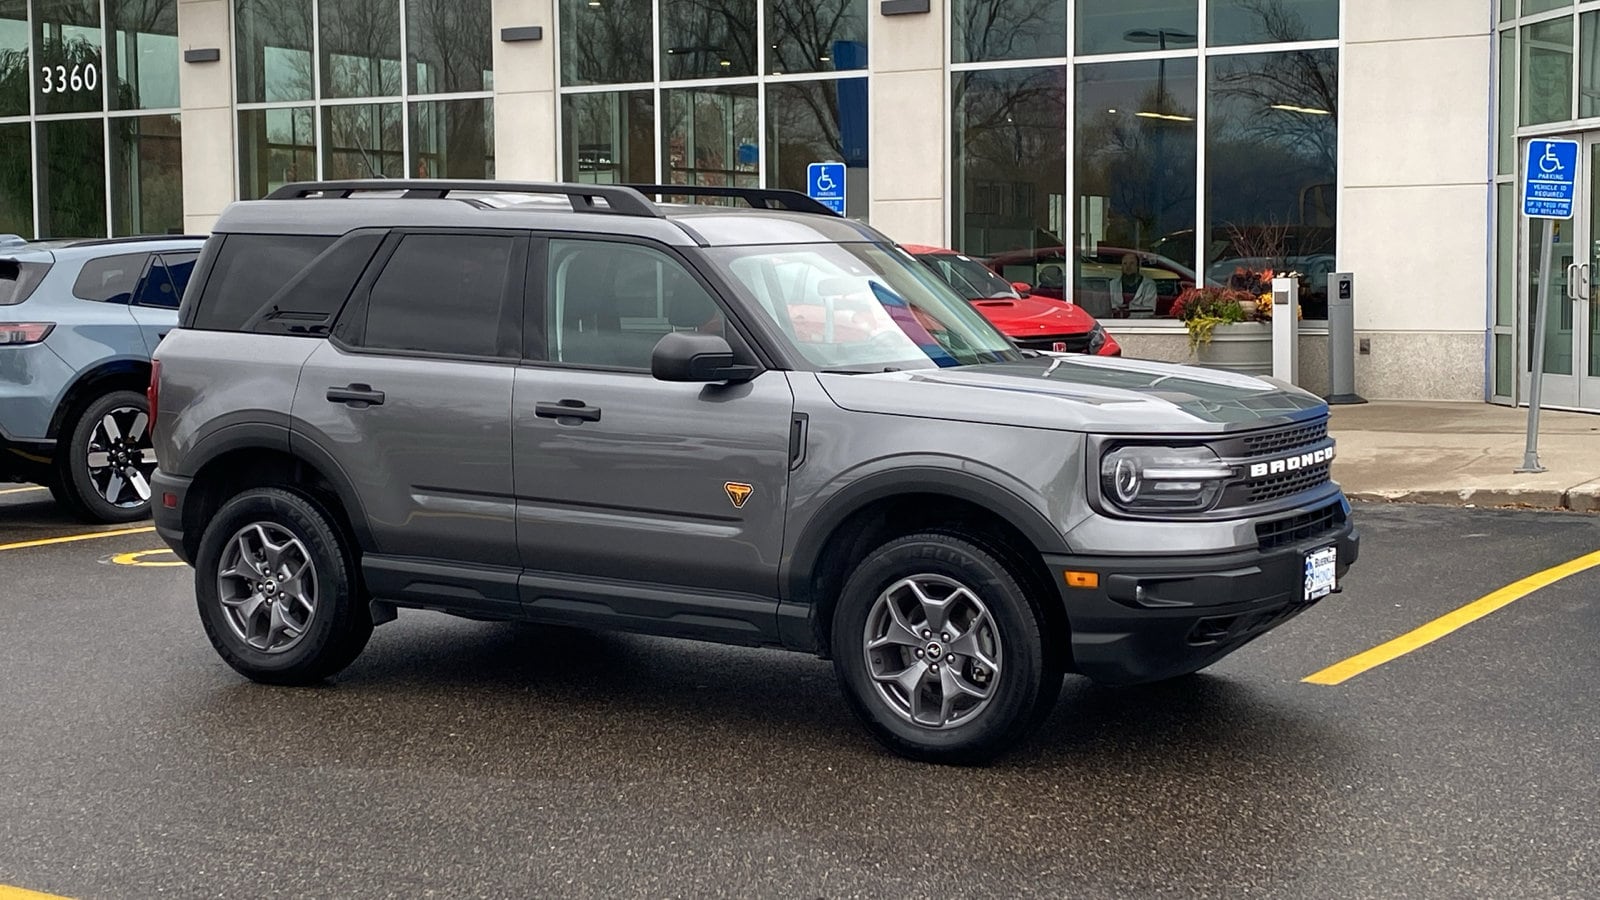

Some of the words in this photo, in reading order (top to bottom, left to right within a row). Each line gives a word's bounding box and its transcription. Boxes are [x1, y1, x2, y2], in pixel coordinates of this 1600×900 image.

[42, 63, 97, 94] 3360
[1250, 446, 1334, 478] BRONCO
[907, 546, 974, 567] KELLY
